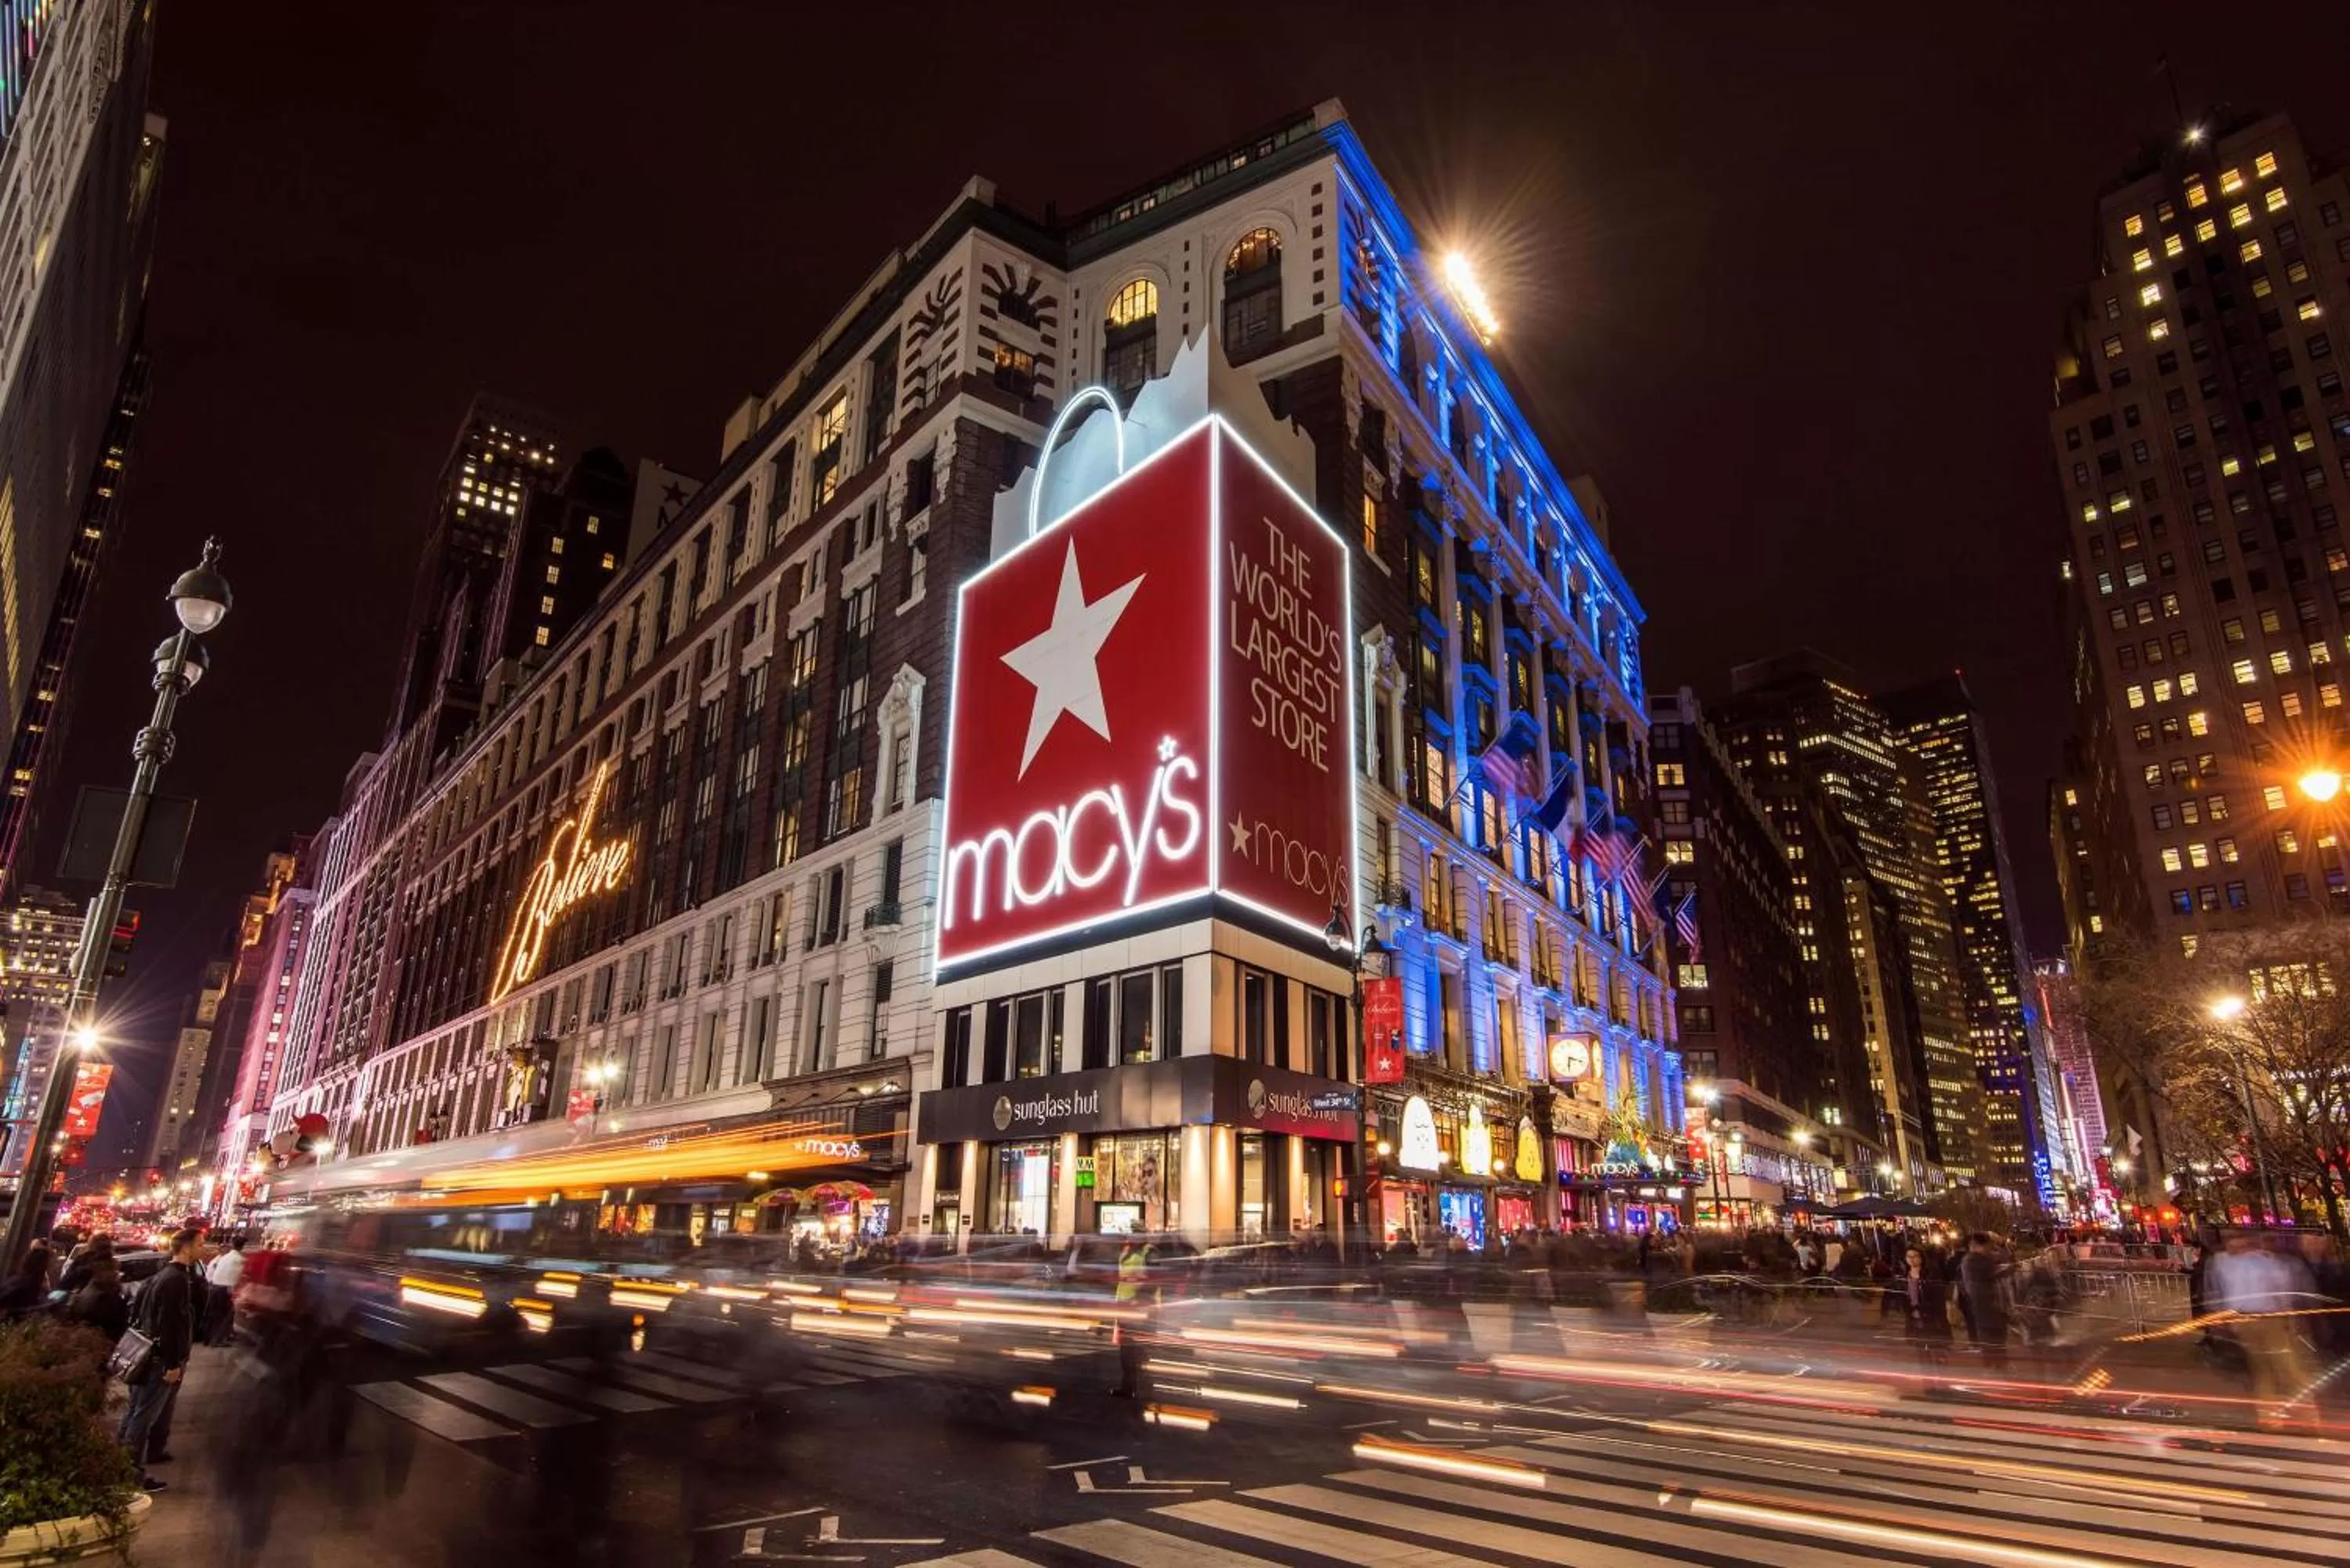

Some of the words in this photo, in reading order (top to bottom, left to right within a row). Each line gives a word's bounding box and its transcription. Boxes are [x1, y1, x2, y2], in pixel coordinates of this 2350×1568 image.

[1229, 540, 1342, 674] WORLD'S
[1263, 515, 1312, 599] THE
[1231, 600, 1341, 724] LARGEST
[1251, 677, 1329, 774] STORE
[490, 762, 629, 1006] Believe
[942, 735, 1201, 930] macy's
[1255, 820, 1349, 915] macy's
[1014, 1092, 1072, 1126] sunglass
[1073, 1089, 1099, 1115] hut
